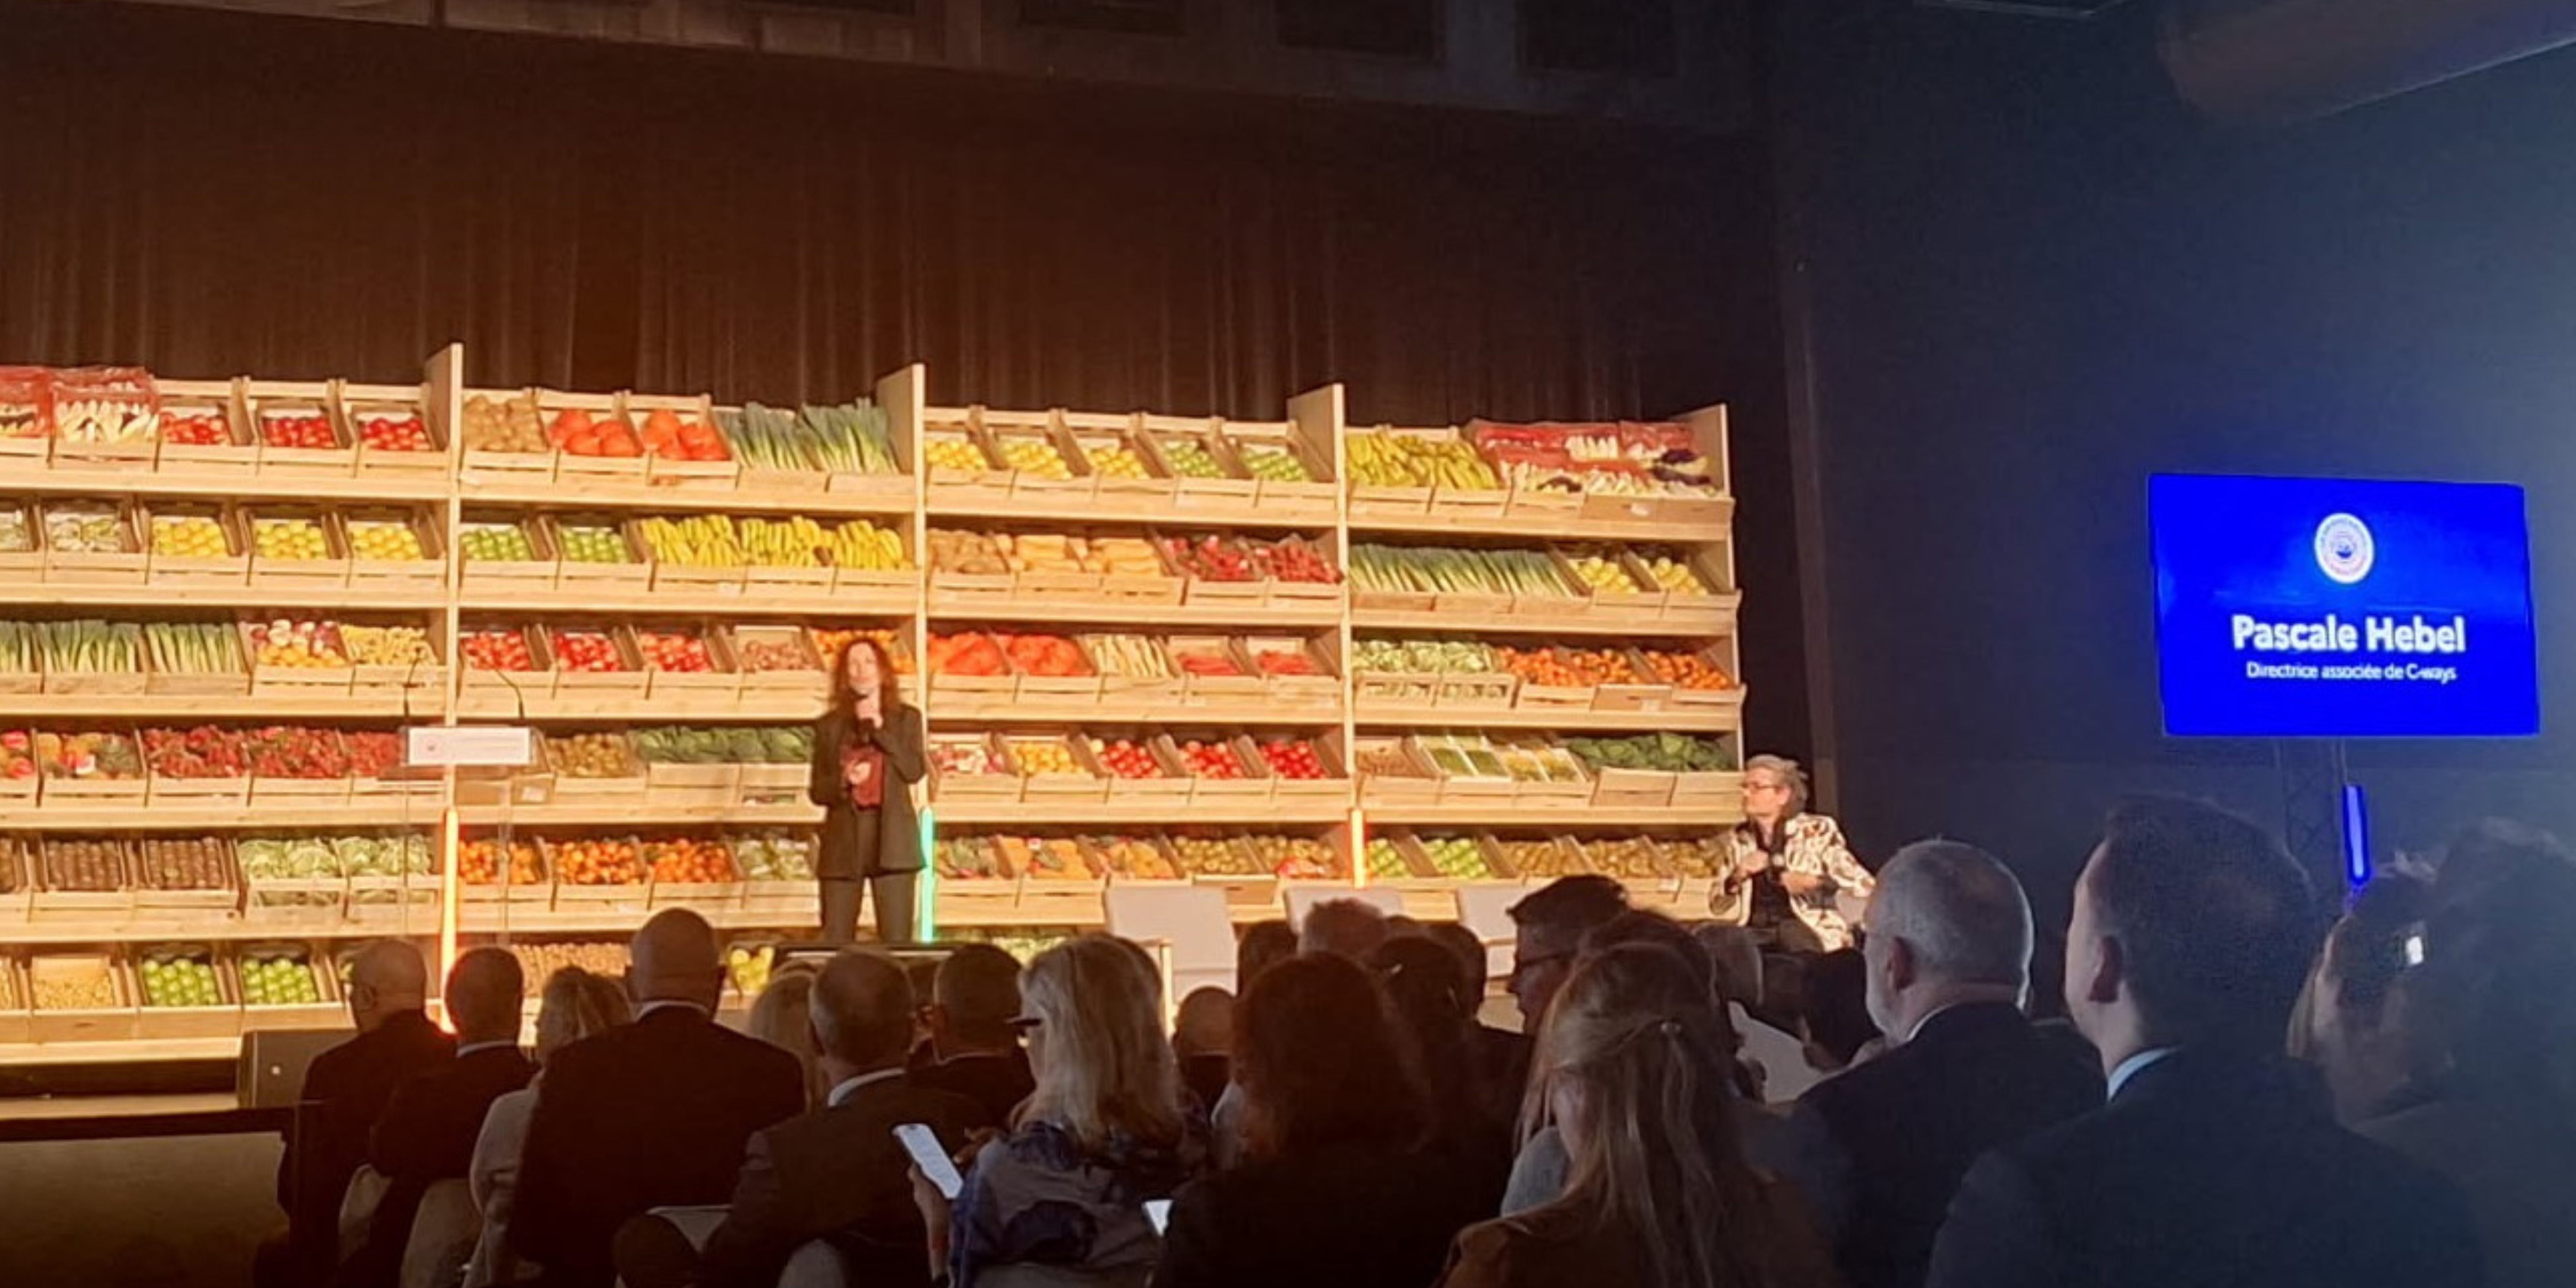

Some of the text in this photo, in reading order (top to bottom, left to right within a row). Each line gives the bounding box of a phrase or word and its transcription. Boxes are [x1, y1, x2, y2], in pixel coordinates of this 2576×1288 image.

[2232, 614, 2465, 653] Pascale Hebel
[2247, 662, 2318, 679] Directrice
[2384, 663, 2404, 679] de
